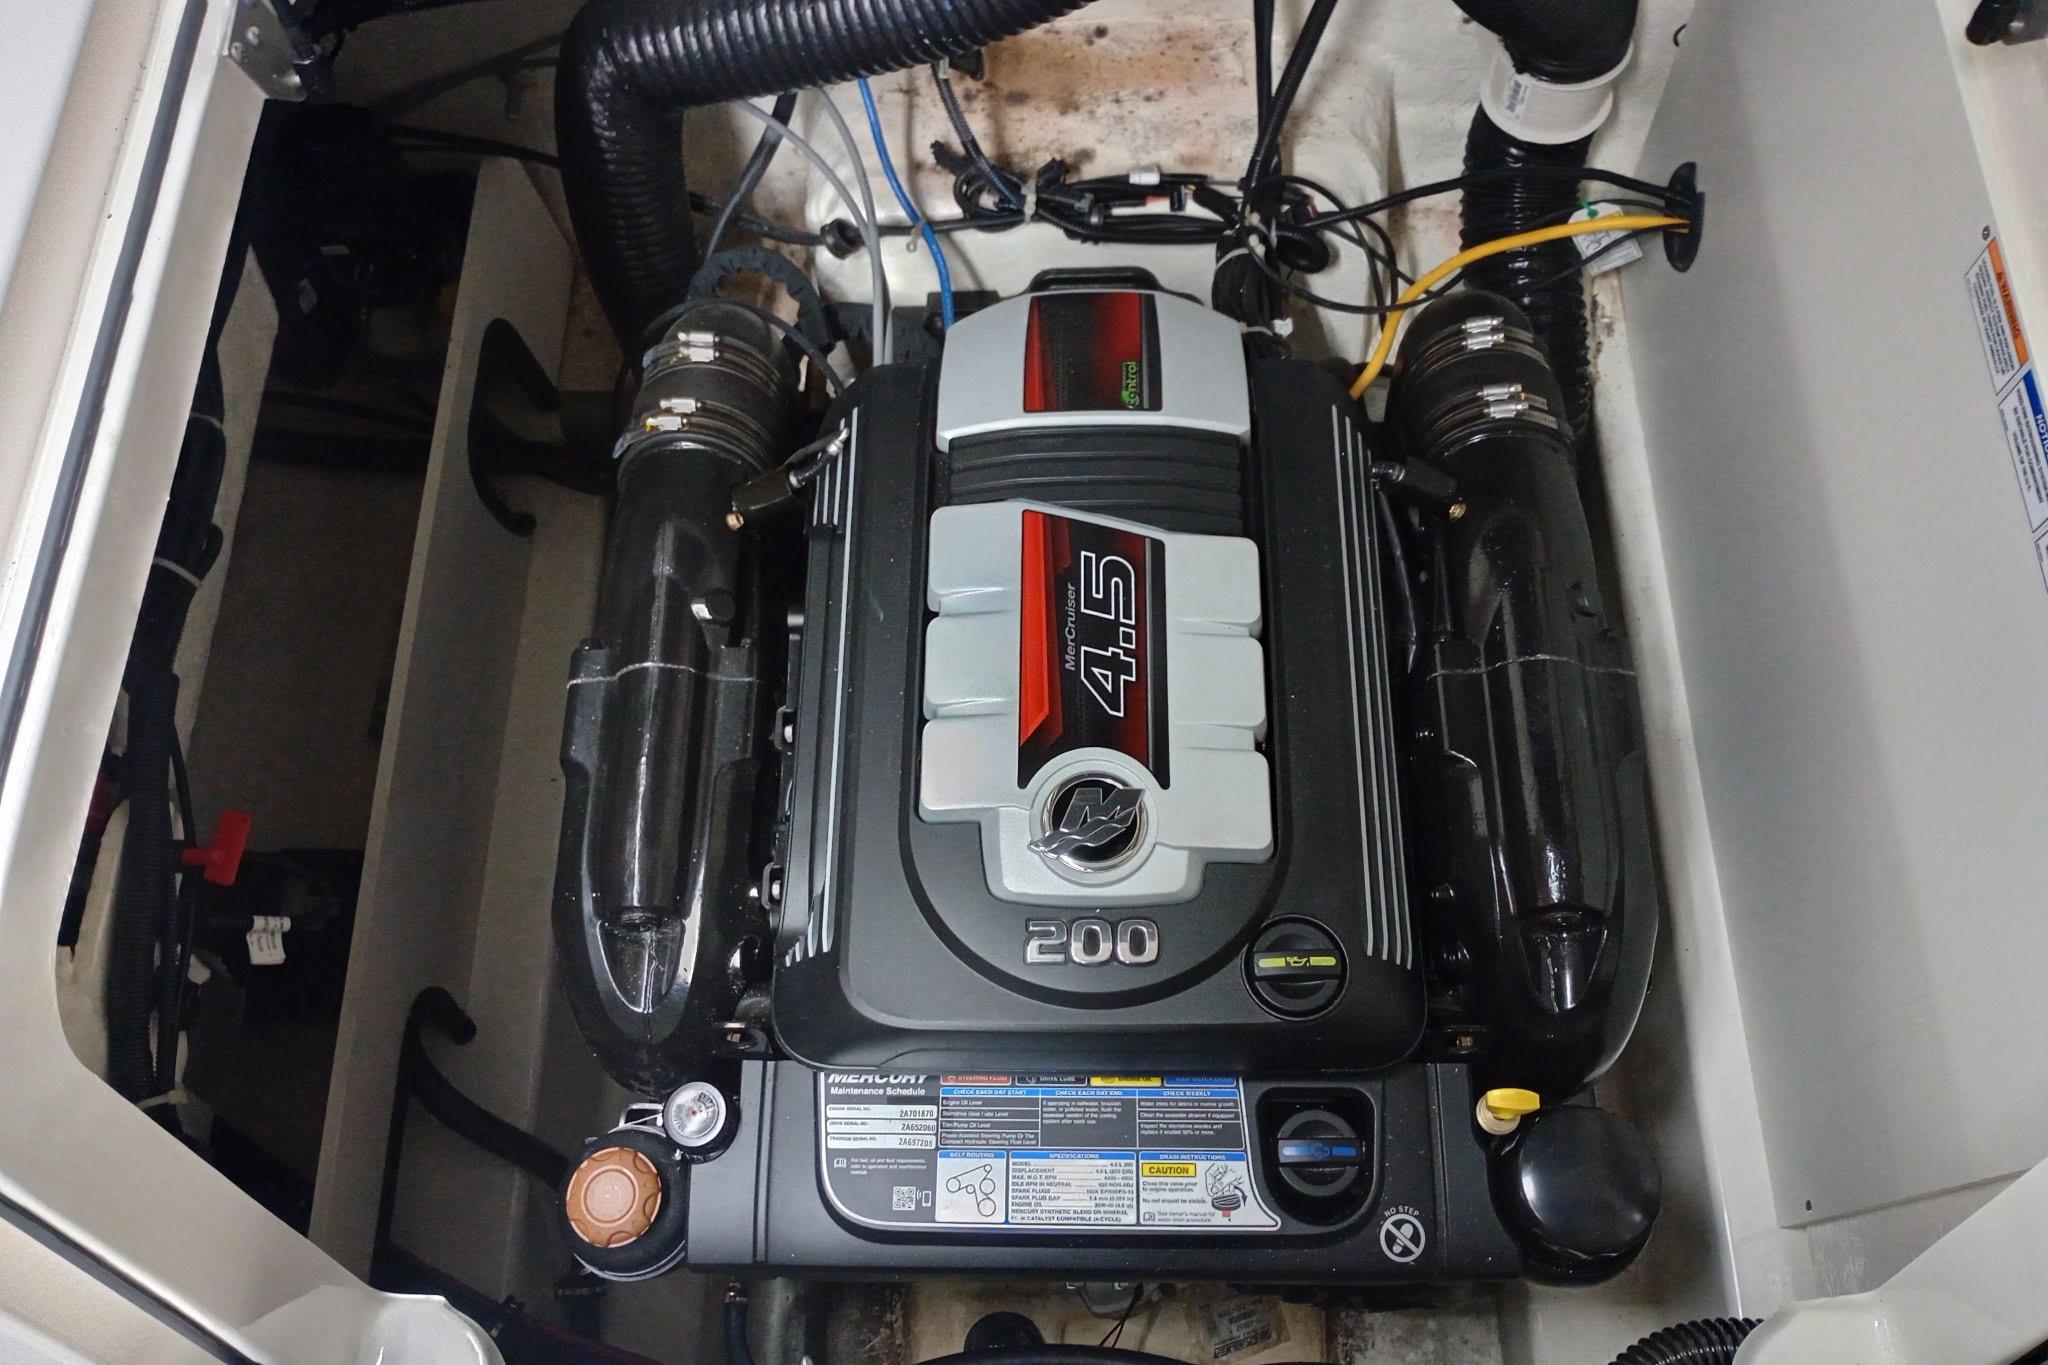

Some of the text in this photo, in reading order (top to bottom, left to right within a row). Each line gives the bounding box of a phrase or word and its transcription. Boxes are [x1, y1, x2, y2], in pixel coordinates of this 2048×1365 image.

[1064, 581, 1076, 671] MerCruiser
[1081, 551, 1136, 717] 4.5
[1024, 918, 1160, 965] 200
[830, 1086, 926, 1095] Maintenance Schedule
[1149, 1166, 1189, 1175] CAUTION
[1384, 1205, 1420, 1217] NO STEP
